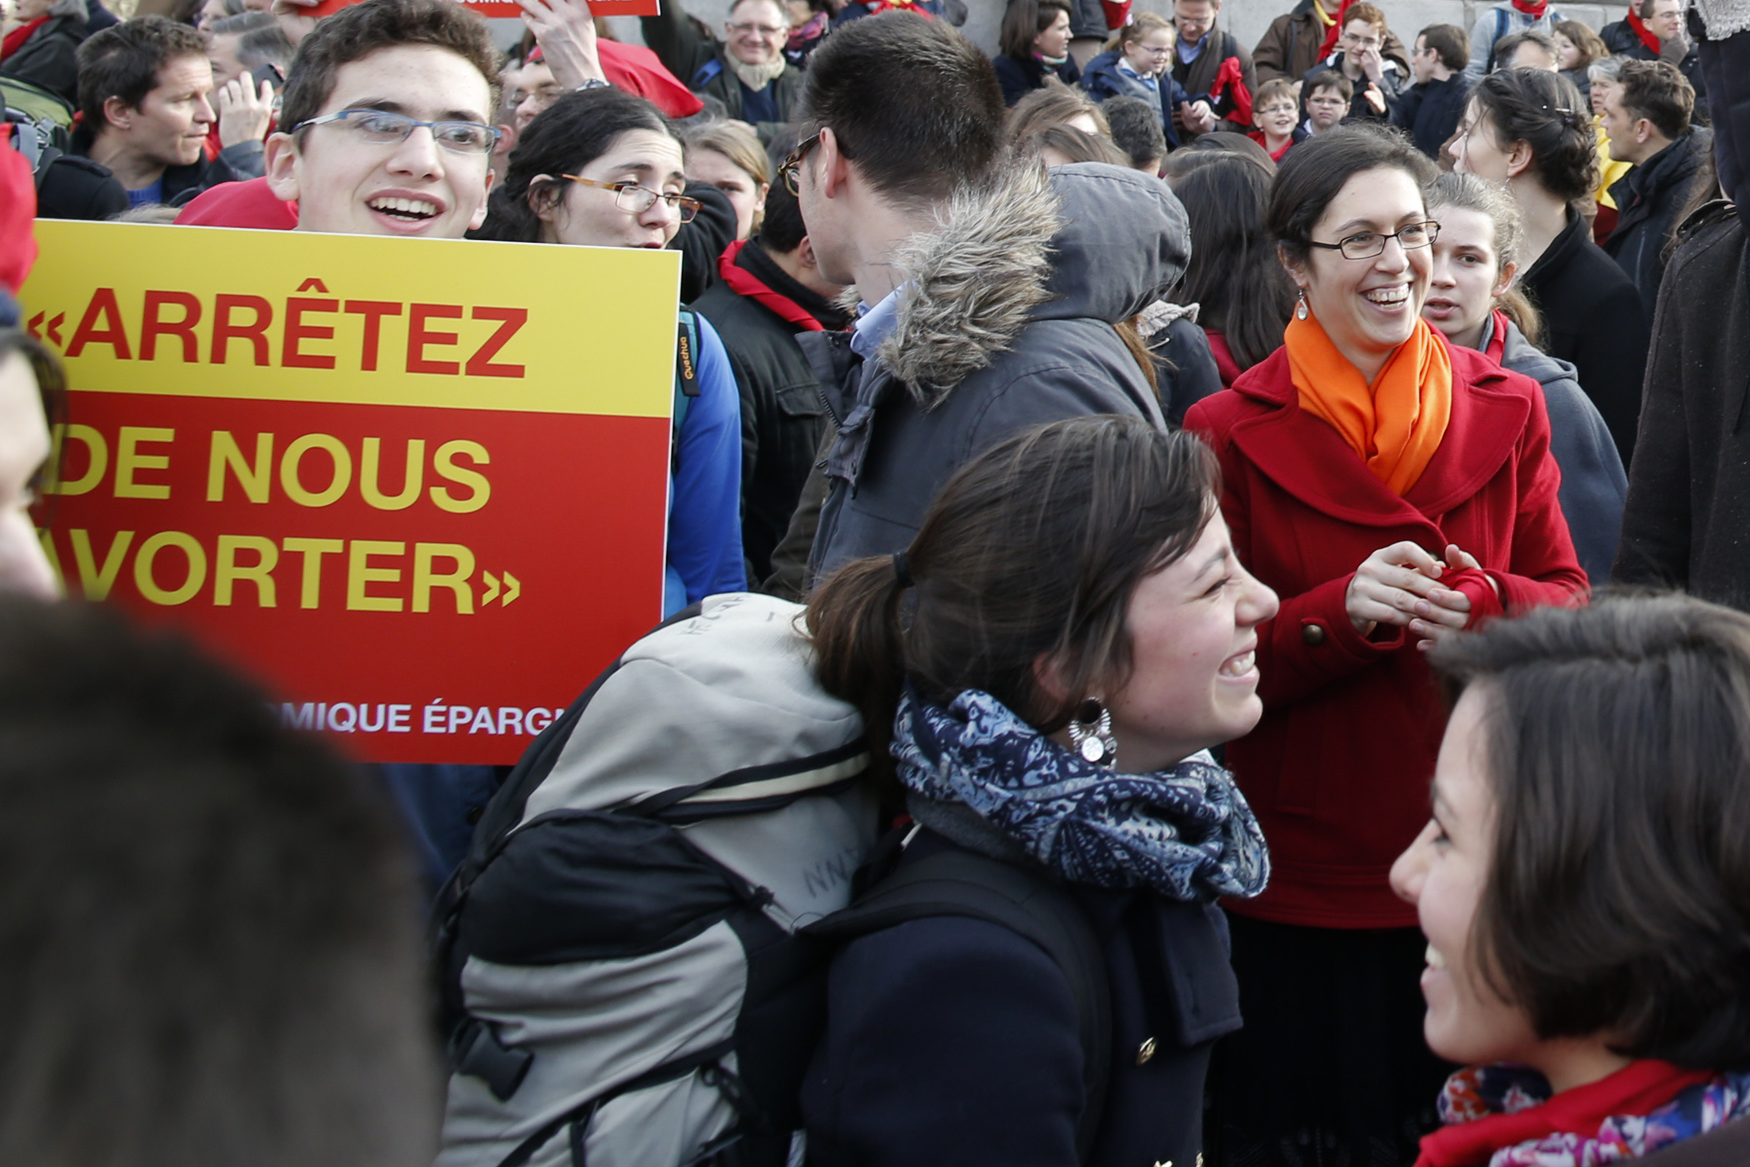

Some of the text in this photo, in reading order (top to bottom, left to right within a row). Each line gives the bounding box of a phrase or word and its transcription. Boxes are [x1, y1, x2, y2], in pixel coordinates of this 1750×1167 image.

[27, 277, 528, 380] «ARRÊTEZ
[42, 423, 491, 514] DE NOUS
[281, 697, 566, 737] MIQUE ÉPARG
